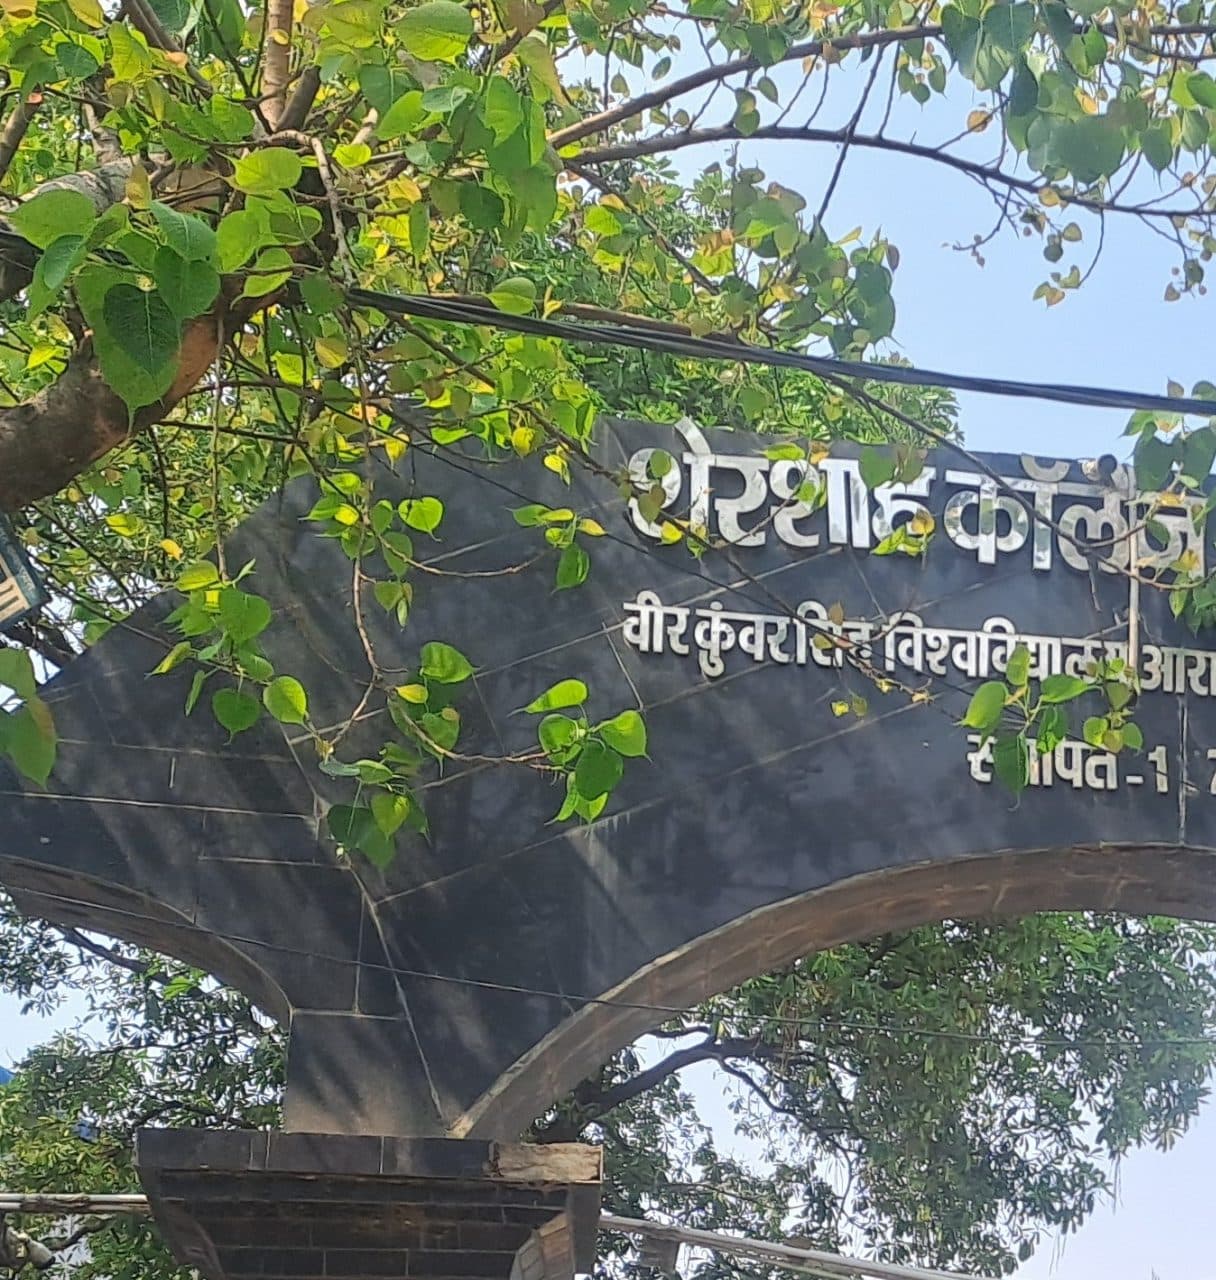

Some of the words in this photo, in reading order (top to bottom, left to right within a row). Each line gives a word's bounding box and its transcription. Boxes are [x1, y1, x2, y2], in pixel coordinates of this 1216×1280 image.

[628, 420, 936, 550] शेरशाह
[623, 590, 690, 655] वीर
[694, 601, 791, 677] कुंवर
